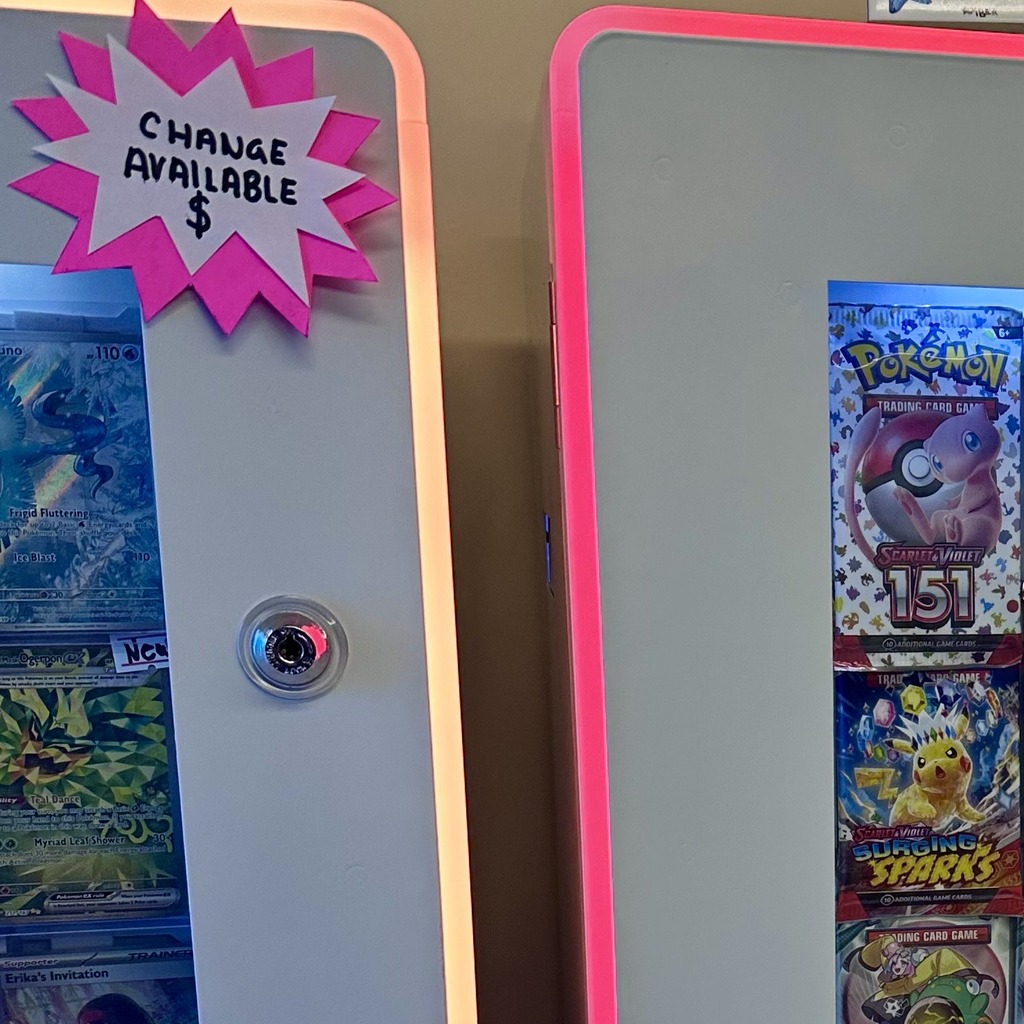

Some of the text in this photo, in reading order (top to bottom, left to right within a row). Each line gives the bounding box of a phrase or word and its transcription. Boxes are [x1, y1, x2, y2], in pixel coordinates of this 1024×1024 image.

[139, 111, 287, 166] CHANGE
[124, 147, 298, 206] AVAILABLE
[186, 190, 211, 240] $
[999, 328, 1010, 338] 6+
[95, 346, 120, 360] 110
[877, 401, 953, 413] TRADING CARD
[9, 508, 90, 522] Frigid Fluttering
[14, 552, 28, 562] Ice
[31, 552, 57, 562] Blast
[879, 546, 982, 565] SCARLET VIOLET
[883, 566, 975, 628] 151
[897, 640, 976, 648] ADDITIONAL GAME CARDS
[20, 652, 62, 666] Ogerpon
[30, 795, 80, 804] Teal Dance
[855, 827, 931, 841] SCARLET VIOLET
[34, 834, 166, 849] Myriad Leaf Shower 30
[852, 834, 977, 861] SURGING
[868, 843, 1000, 886] SPARKS
[924, 930, 948, 941] CARD
[951, 929, 978, 940] GAME
[3, 959, 58, 969] Supporter
[6, 967, 109, 984] Erika's Invitation
